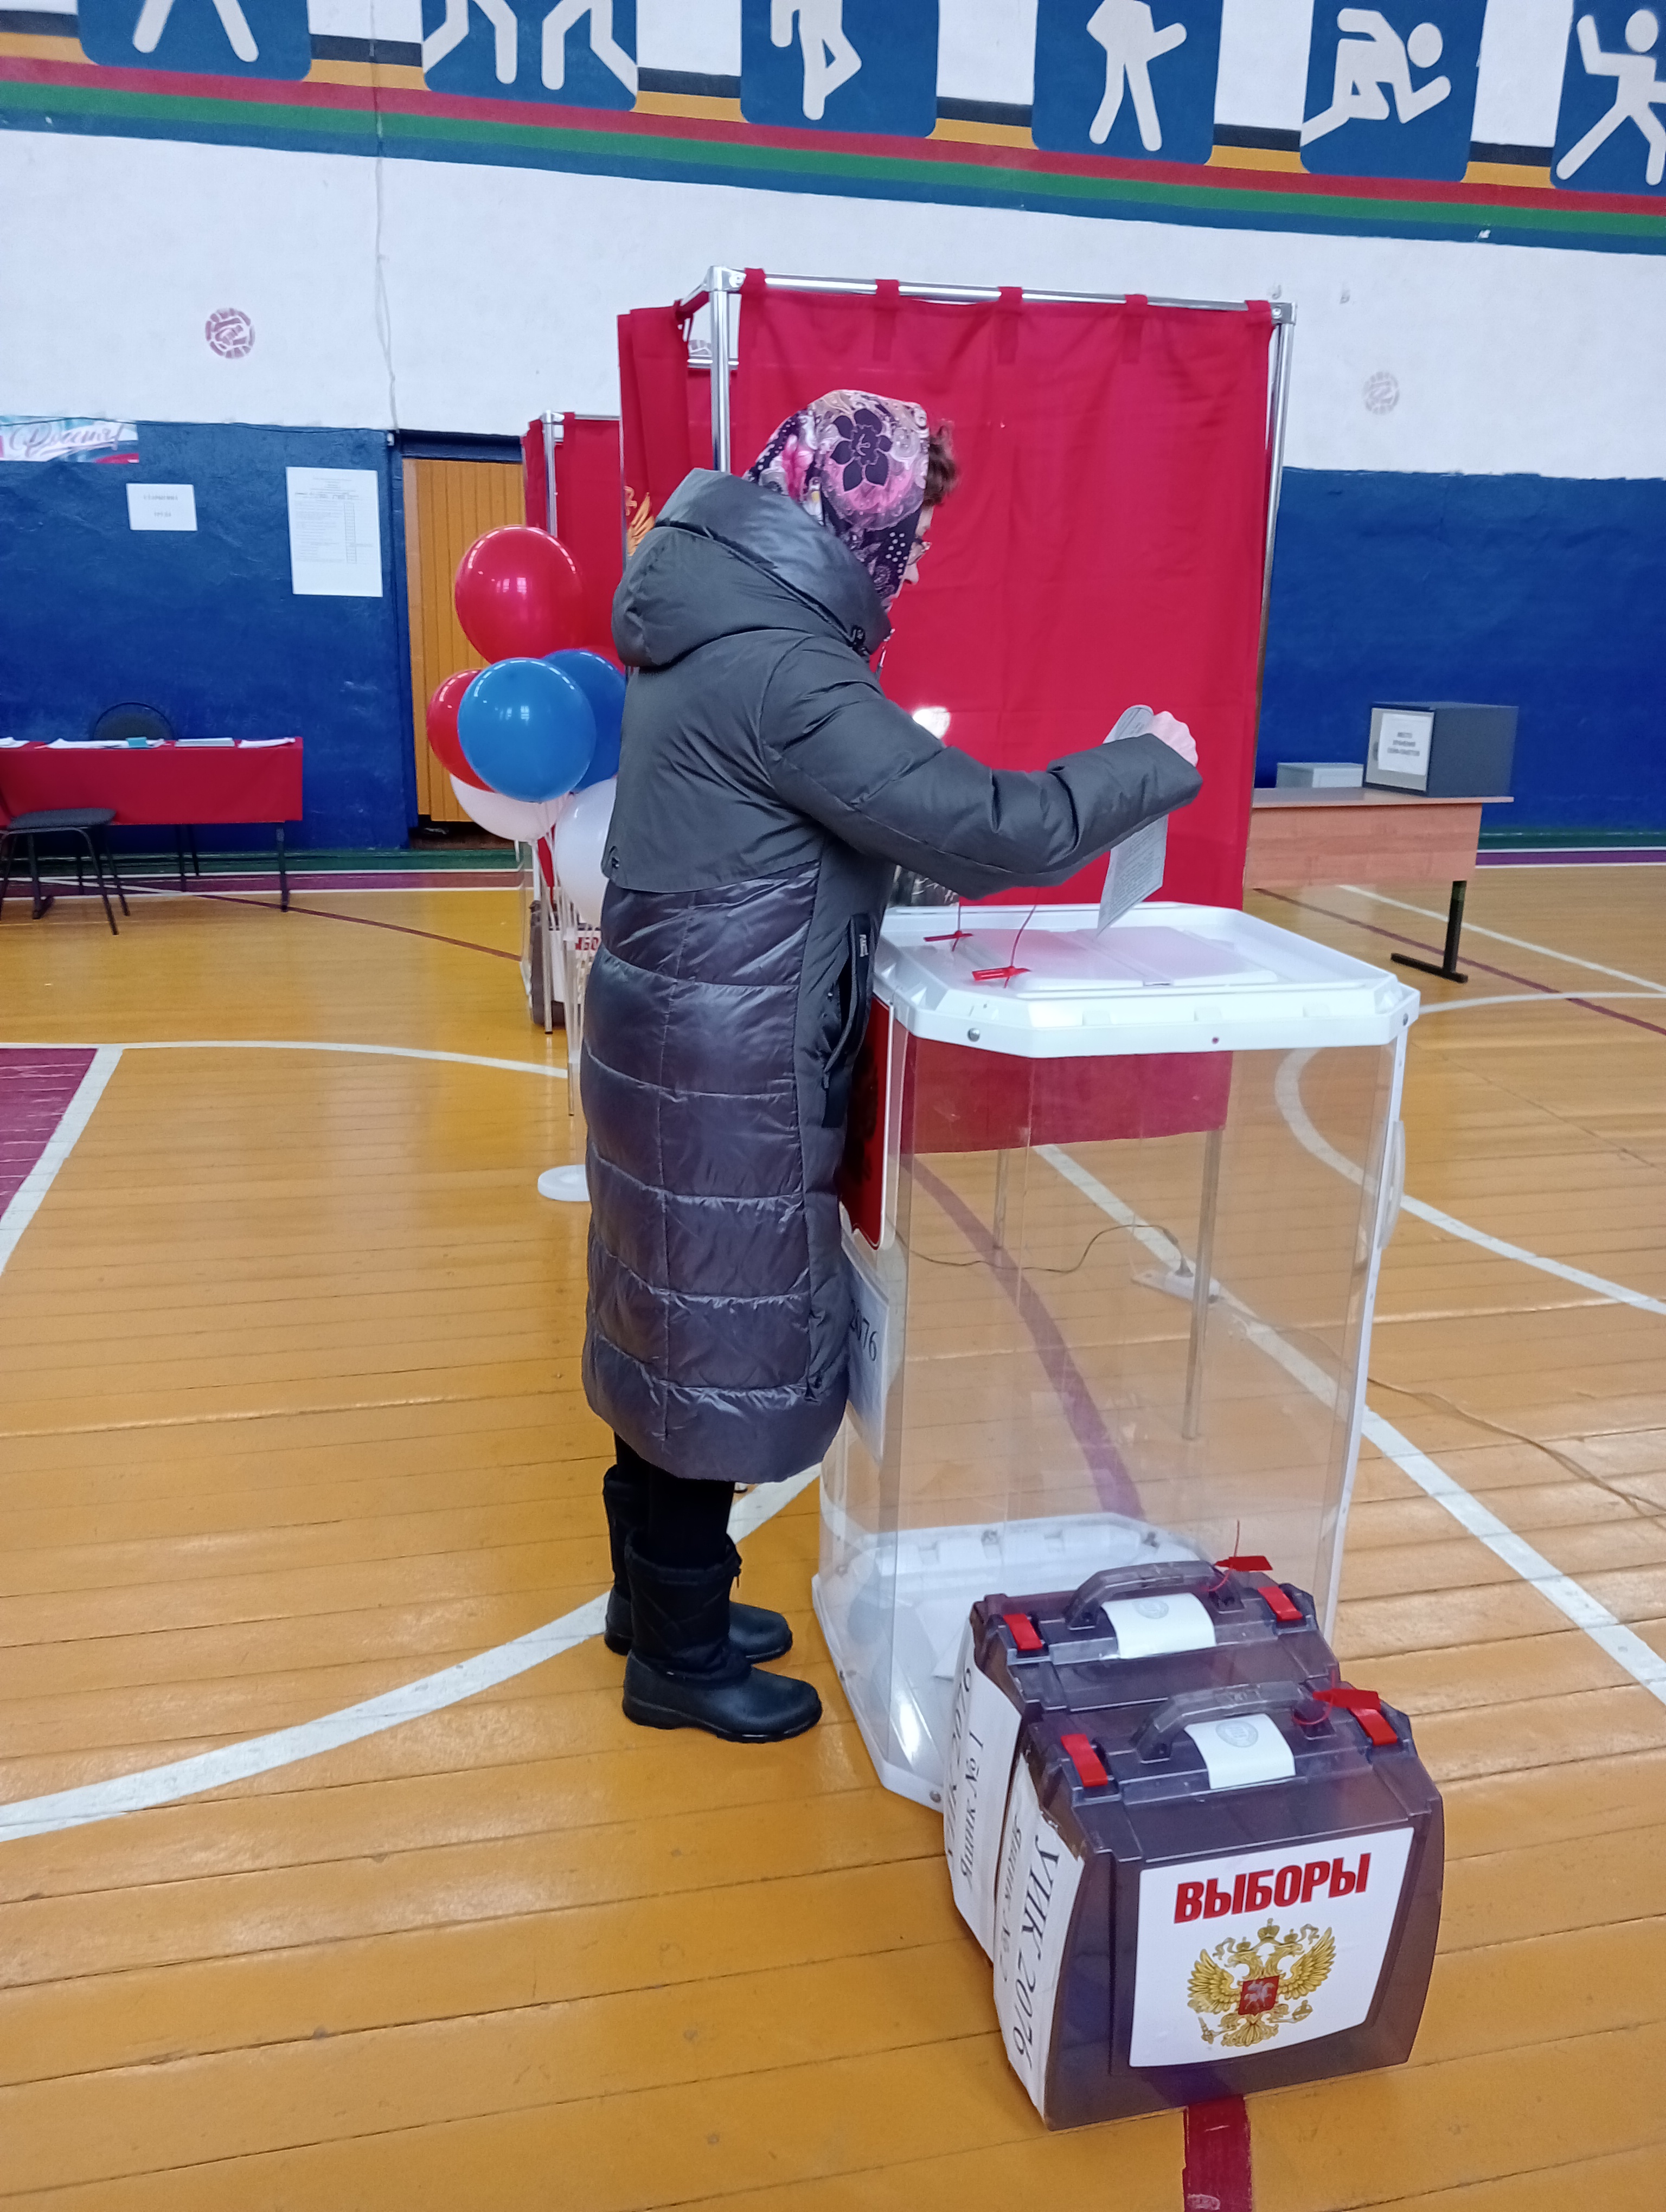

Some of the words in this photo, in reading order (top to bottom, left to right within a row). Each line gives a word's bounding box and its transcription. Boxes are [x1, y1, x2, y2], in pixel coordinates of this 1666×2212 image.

[1021, 1834, 1060, 1961] УИК
[1174, 1852, 1372, 1924] ВЫБОРЫ
[1013, 1947, 1036, 2070] 2076
